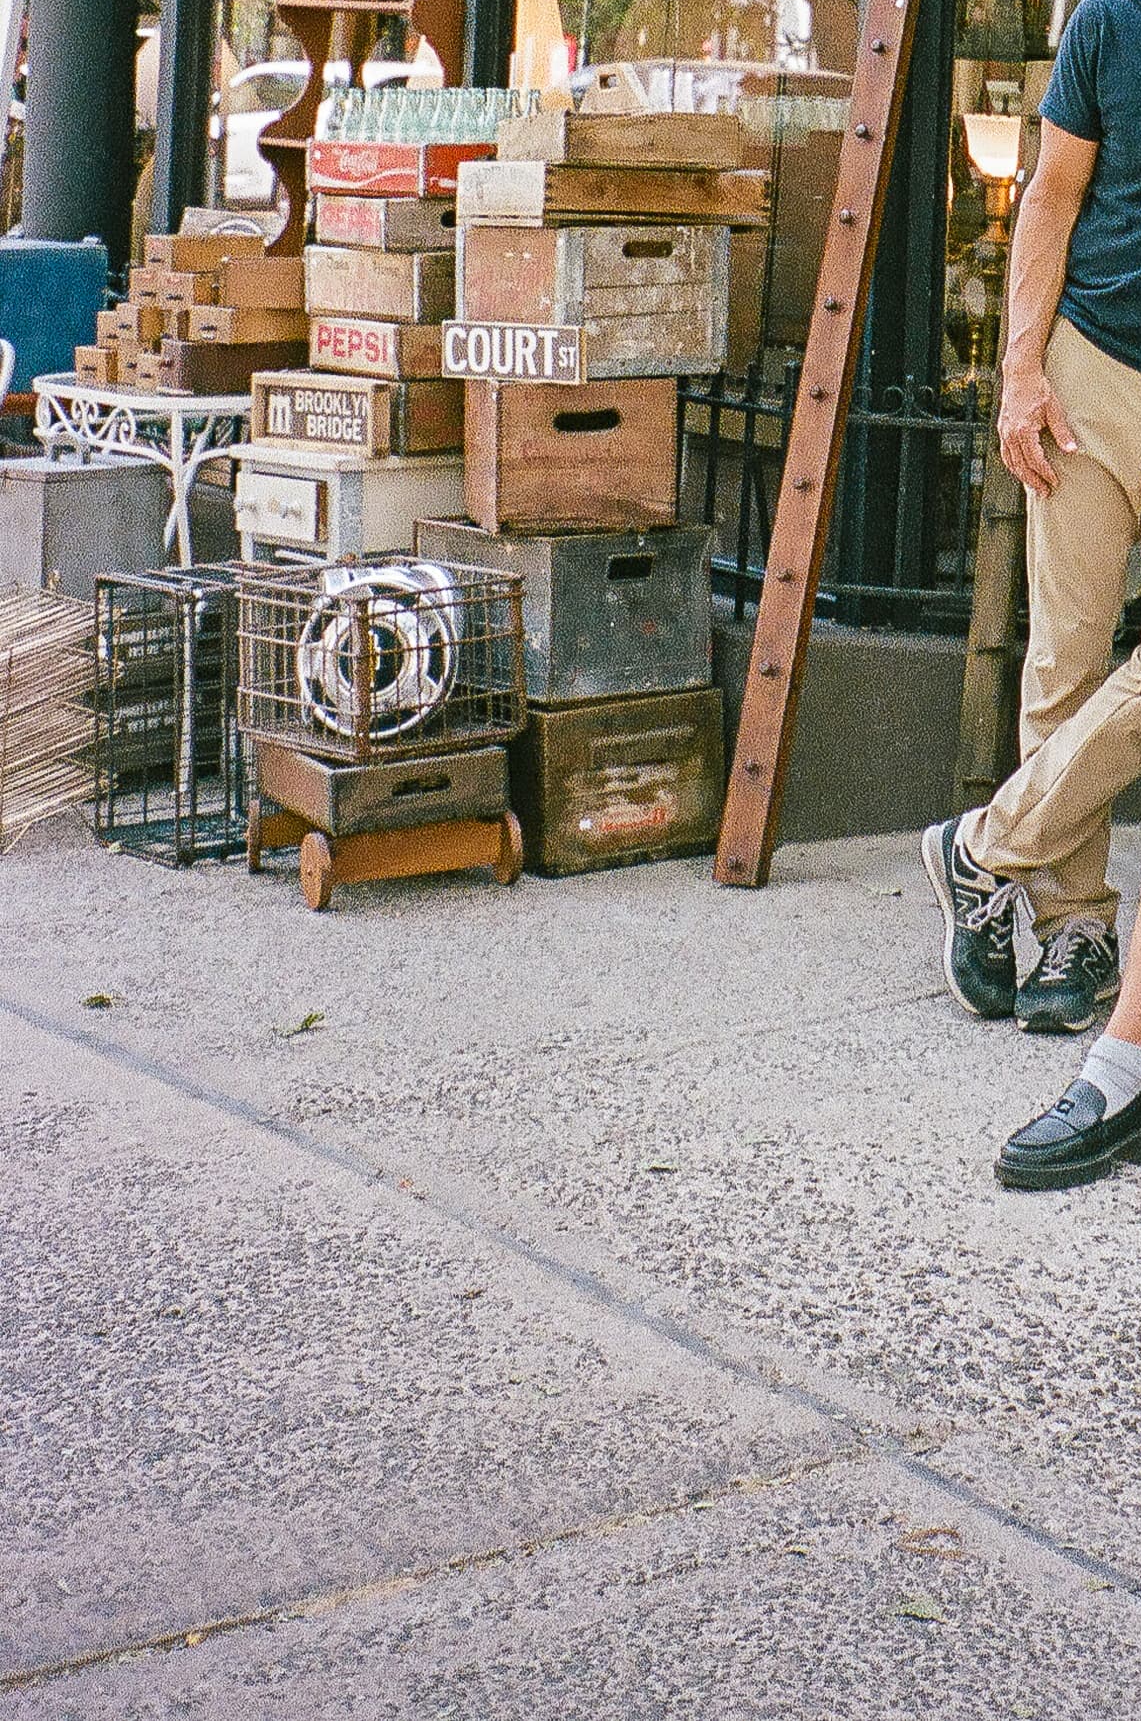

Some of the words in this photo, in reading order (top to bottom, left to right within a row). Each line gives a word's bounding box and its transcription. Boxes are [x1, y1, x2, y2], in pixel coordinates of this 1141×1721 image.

[317, 324, 388, 364] PEPSI
[446, 327, 558, 376] COURT
[558, 346, 576, 368] ST
[295, 390, 369, 417] BROOKLYN
[306, 415, 363, 441] BRIDGE
